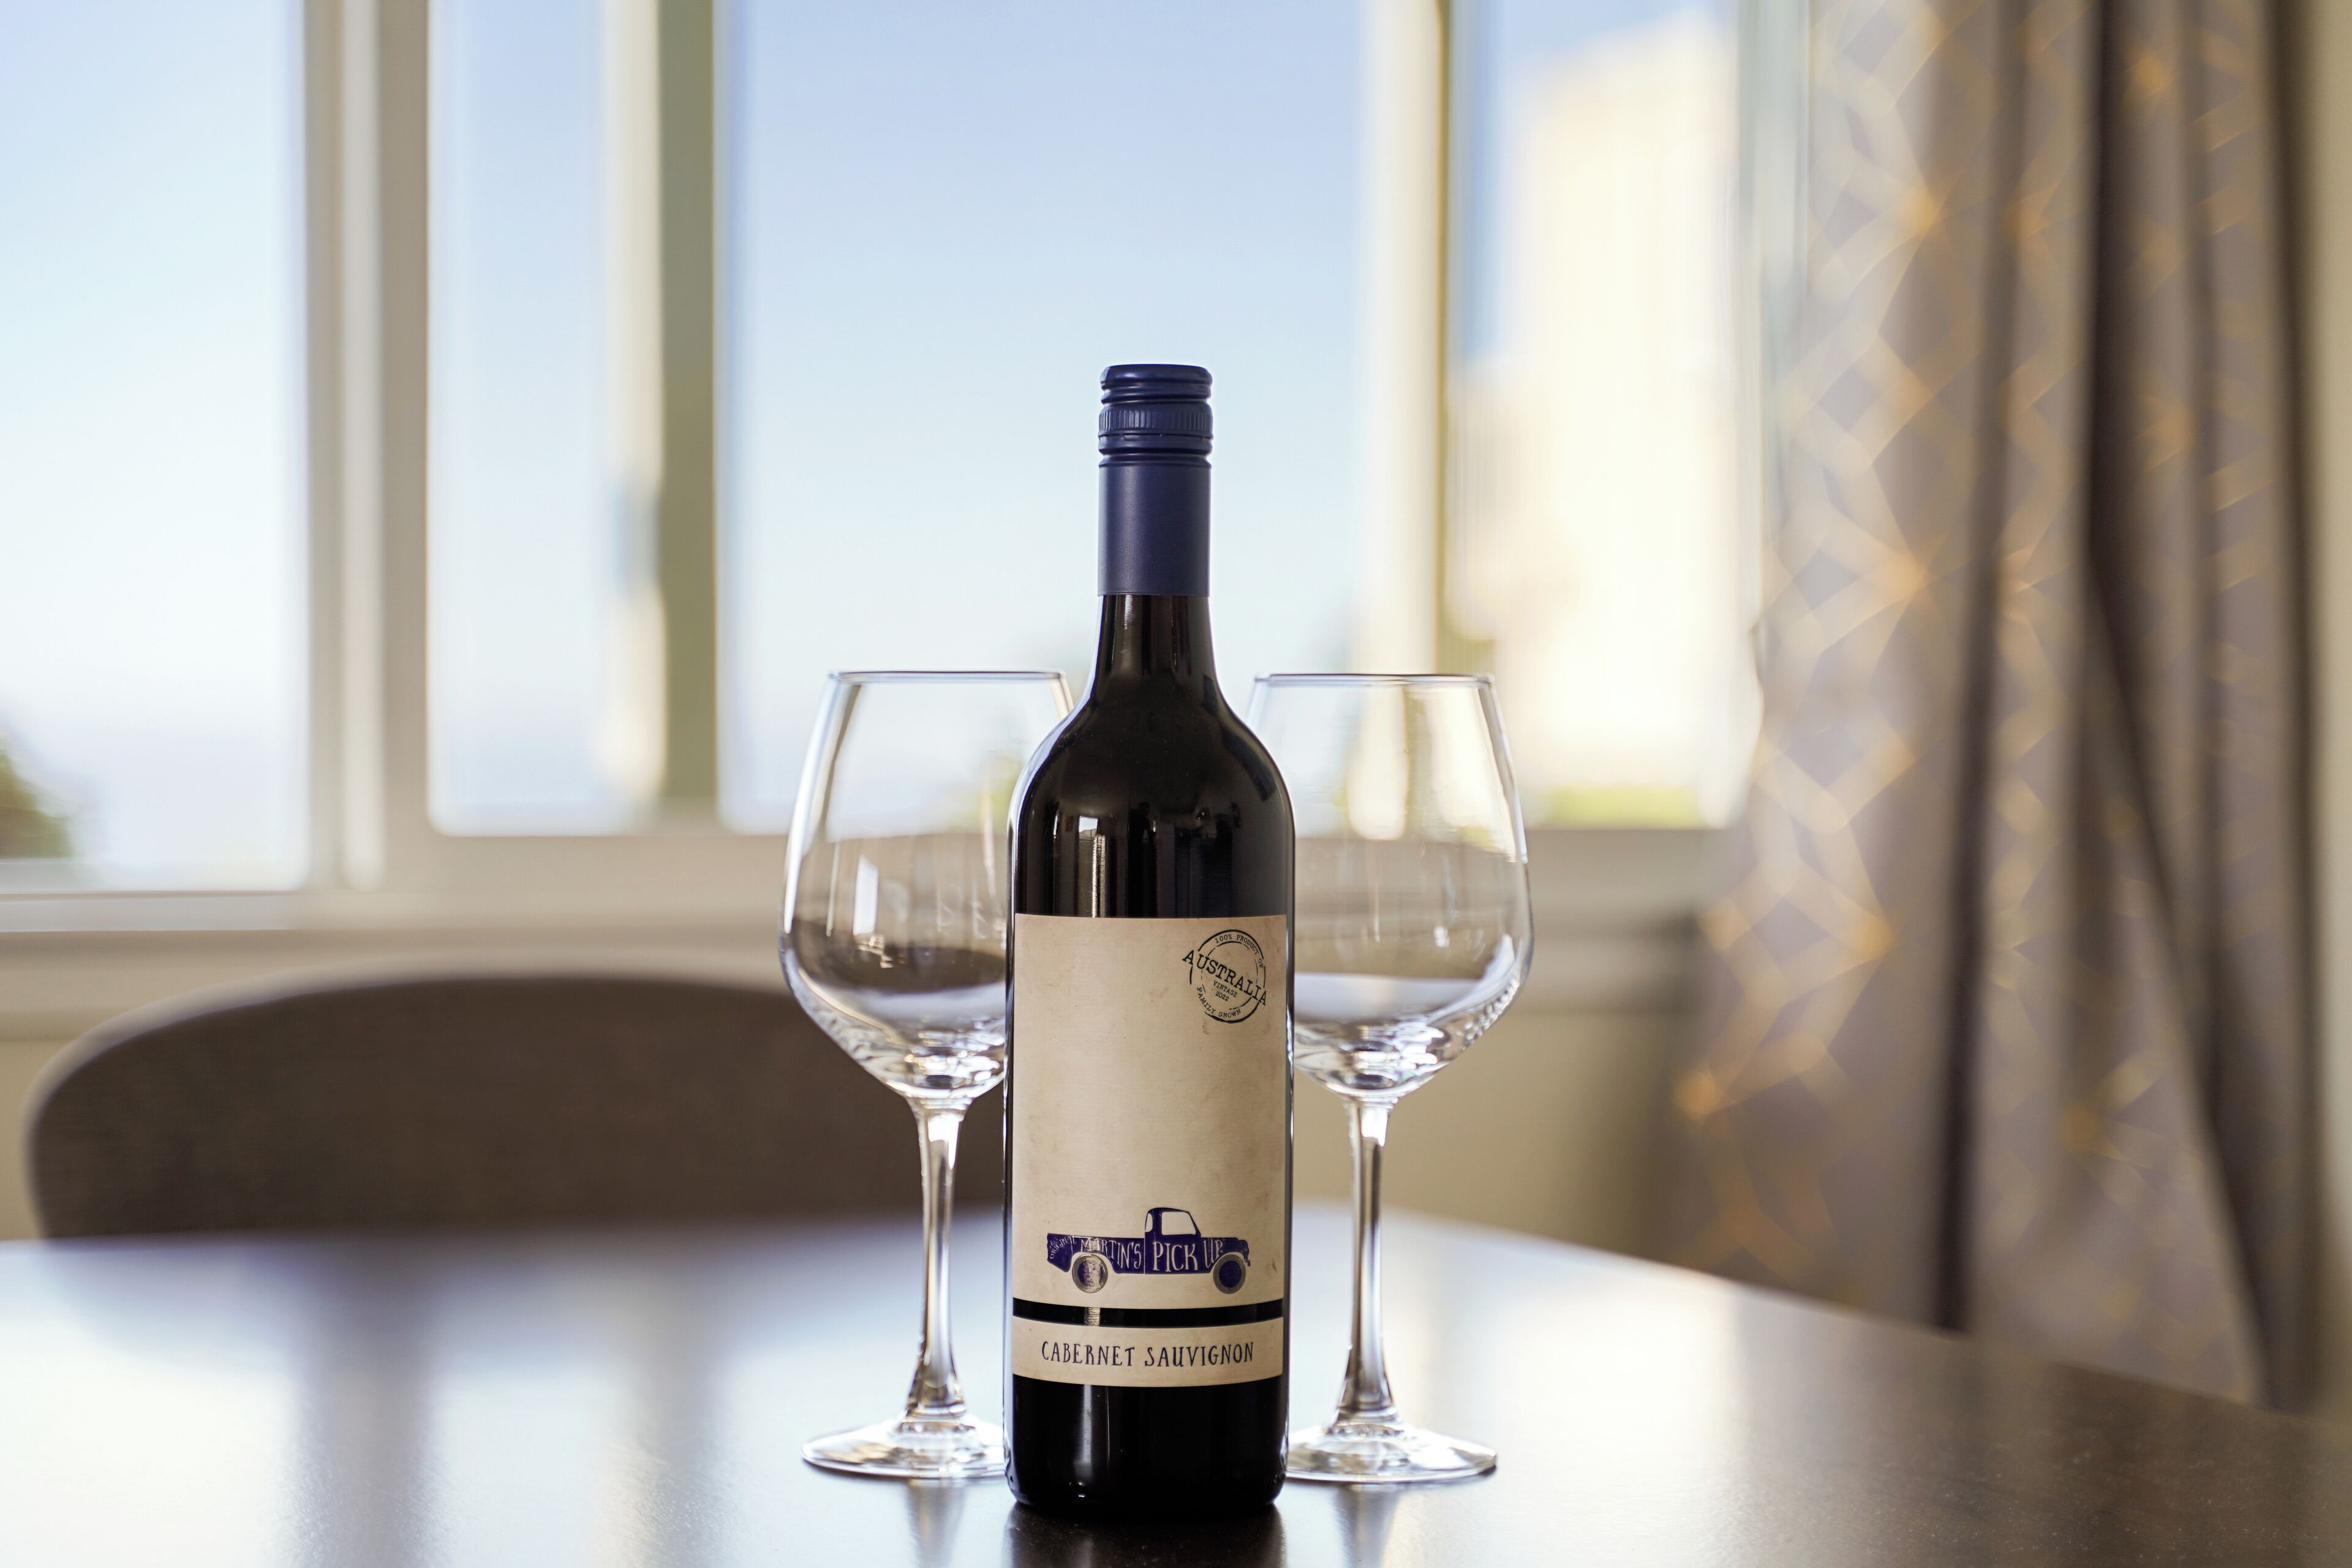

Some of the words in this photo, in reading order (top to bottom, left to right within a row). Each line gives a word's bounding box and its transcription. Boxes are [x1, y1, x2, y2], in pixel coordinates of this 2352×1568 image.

[1215, 934, 1232, 944] 100%
[1237, 934, 1259, 956] PRODUCT
[1258, 959, 1264, 968] OF
[1182, 950, 1267, 1006] AUSTRALIA
[1213, 981, 1238, 998] VINTAGE
[1197, 986, 1216, 1014] FAMILY
[1218, 1009, 1241, 1018] GROWN
[1215, 991, 1229, 1001] 2022
[1153, 1241, 1198, 1272] PICK
[1203, 1239, 1223, 1268] UP
[1041, 1341, 1135, 1366] CABERNET
[1145, 1341, 1254, 1367] SAUVIGNON
